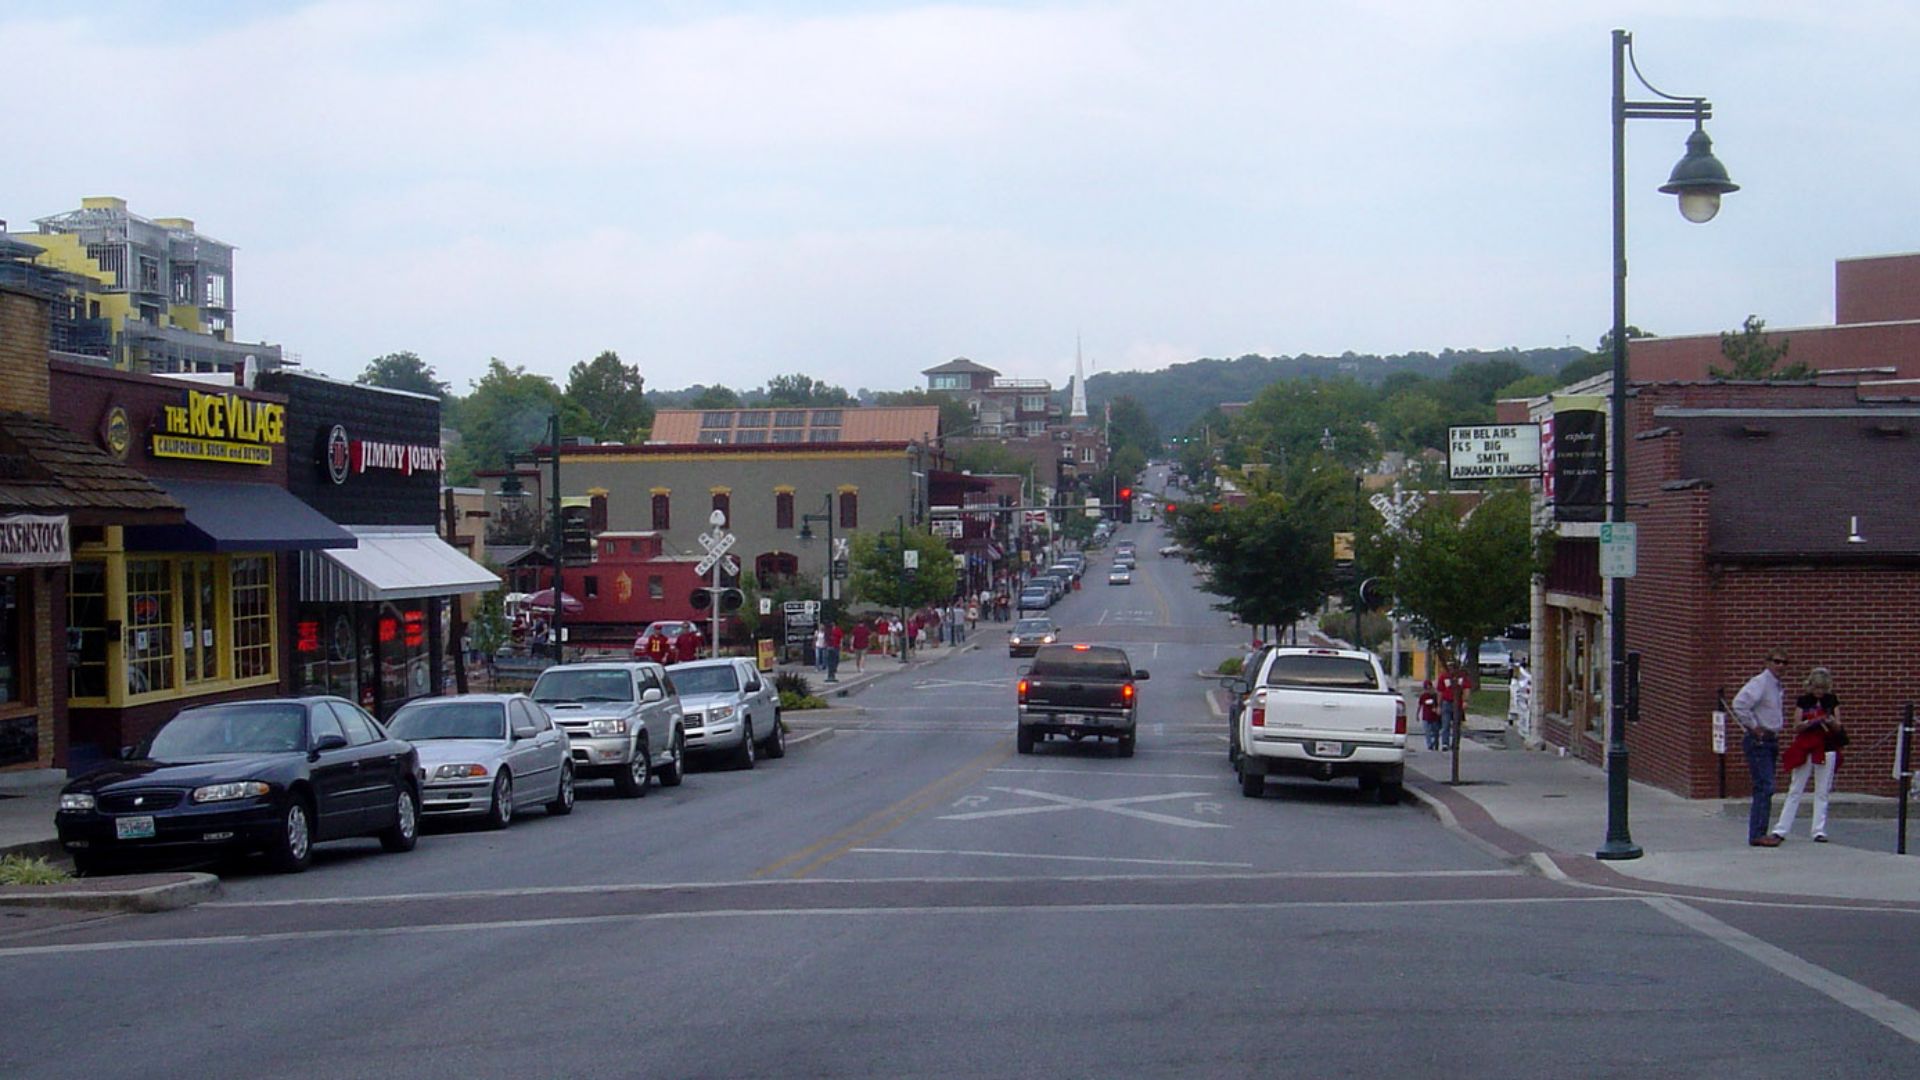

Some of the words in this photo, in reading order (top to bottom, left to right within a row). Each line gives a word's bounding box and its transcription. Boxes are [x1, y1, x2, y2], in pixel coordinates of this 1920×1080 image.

[165, 405, 189, 433] THE
[189, 390, 224, 437] RICE
[220, 392, 285, 443] VILLAGE
[1473, 429, 1490, 439] BEL
[1492, 428, 1517, 438] AIRS
[1484, 441, 1501, 451] BIG
[360, 440, 405, 474] JIMMY
[406, 445, 446, 476] JOHN'S
[1476, 453, 1510, 463] SMITH
